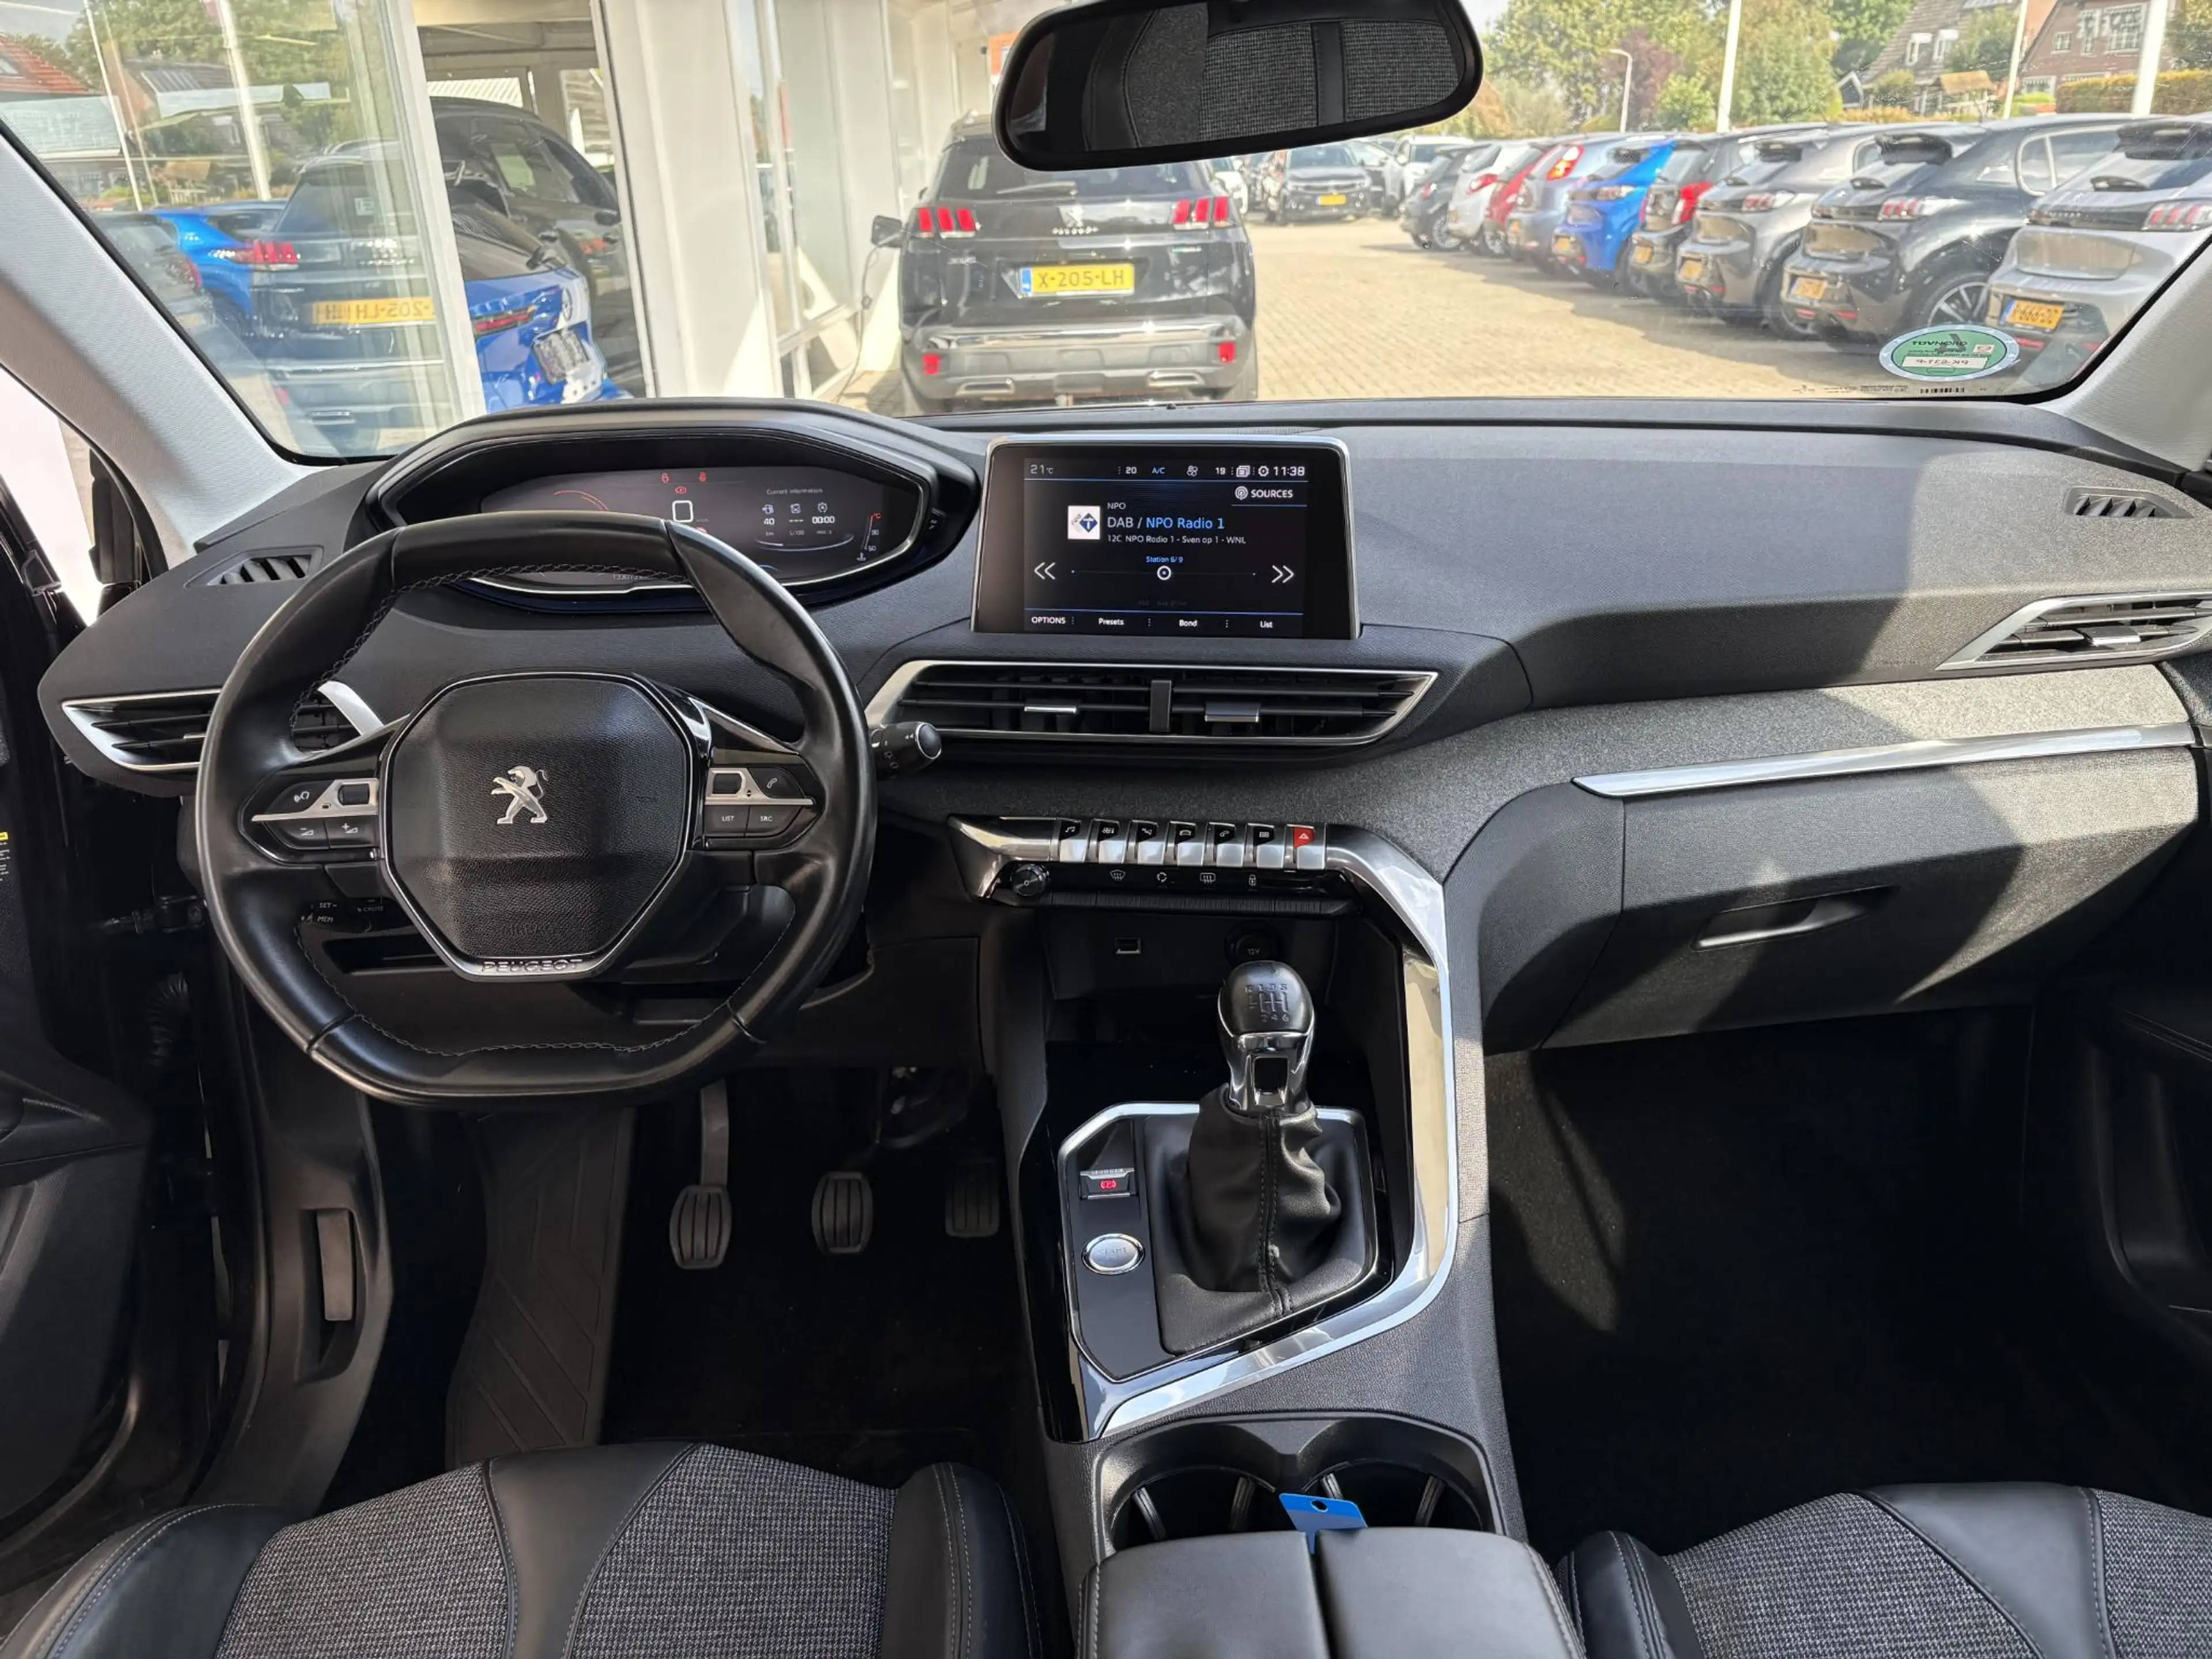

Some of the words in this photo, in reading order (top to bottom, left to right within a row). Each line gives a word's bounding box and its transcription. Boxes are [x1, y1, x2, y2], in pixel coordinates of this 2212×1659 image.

[1037, 270, 1124, 288] X-205-LH
[1273, 467, 1306, 476] 11:38
[1251, 490, 1293, 498] SOURCES
[1107, 502, 1126, 510] NPO
[1107, 517, 1133, 528] DAB
[1146, 518, 1173, 528] NPO
[1177, 518, 1213, 529] Radio
[1218, 518, 1225, 529] 1
[1126, 535, 1144, 543] NPO
[1146, 535, 1168, 543] Radio
[1226, 536, 1246, 544] WNL
[1031, 616, 1066, 624] OPTIONS
[1098, 618, 1124, 626] Presets
[482, 959, 582, 972] PEUGEOT
[1260, 1014, 1268, 1022] 2
[1271, 1013, 1279, 1021] 4
[1282, 1014, 1290, 1022] 6
